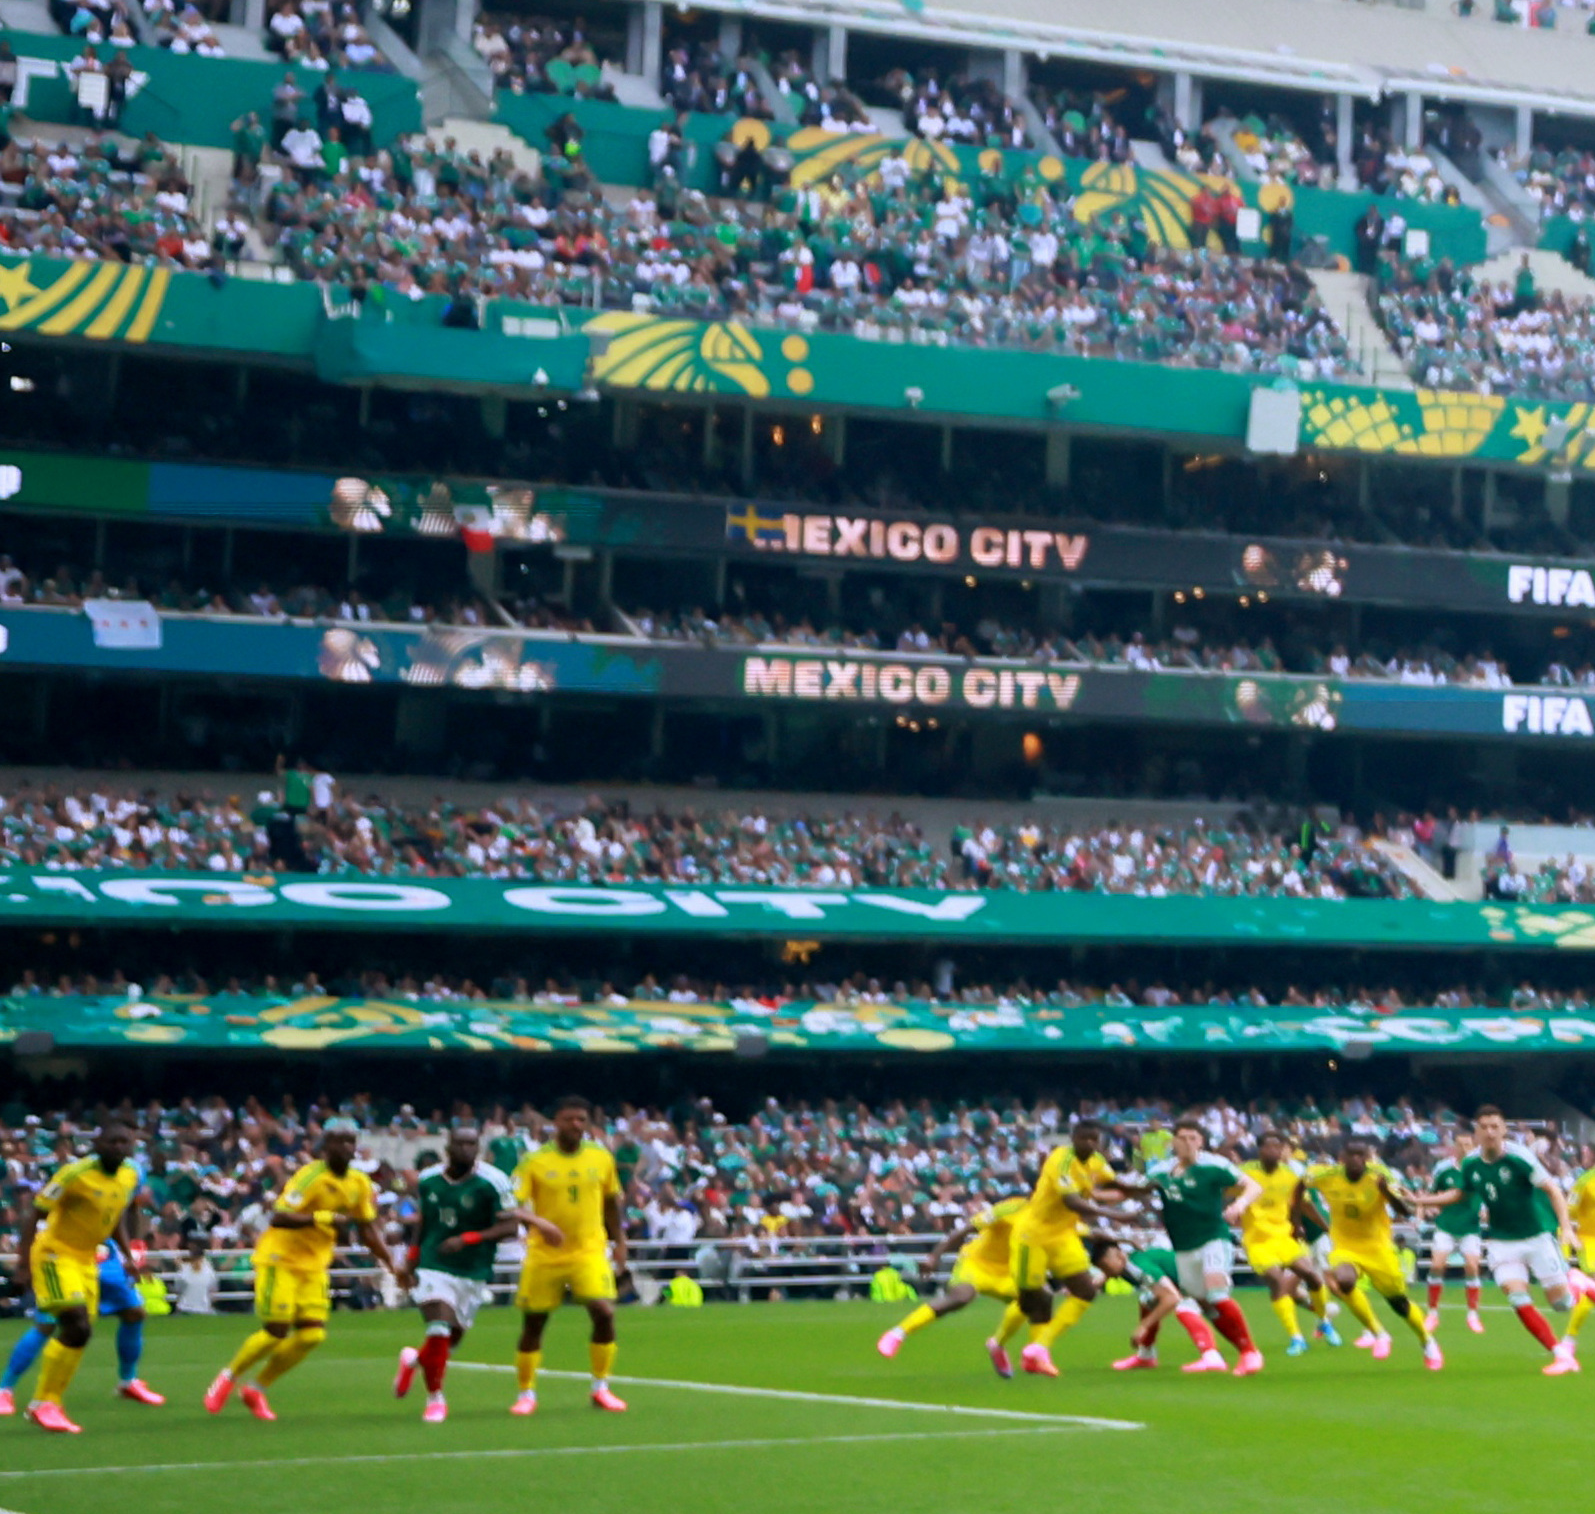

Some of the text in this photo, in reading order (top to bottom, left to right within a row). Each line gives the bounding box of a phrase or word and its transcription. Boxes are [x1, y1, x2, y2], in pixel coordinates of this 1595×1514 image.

[969, 526, 1090, 571] CITY
[743, 657, 1081, 711] MEXICO CITY
[1502, 695, 1594, 736] FIFA
[503, 886, 987, 922] CITY
